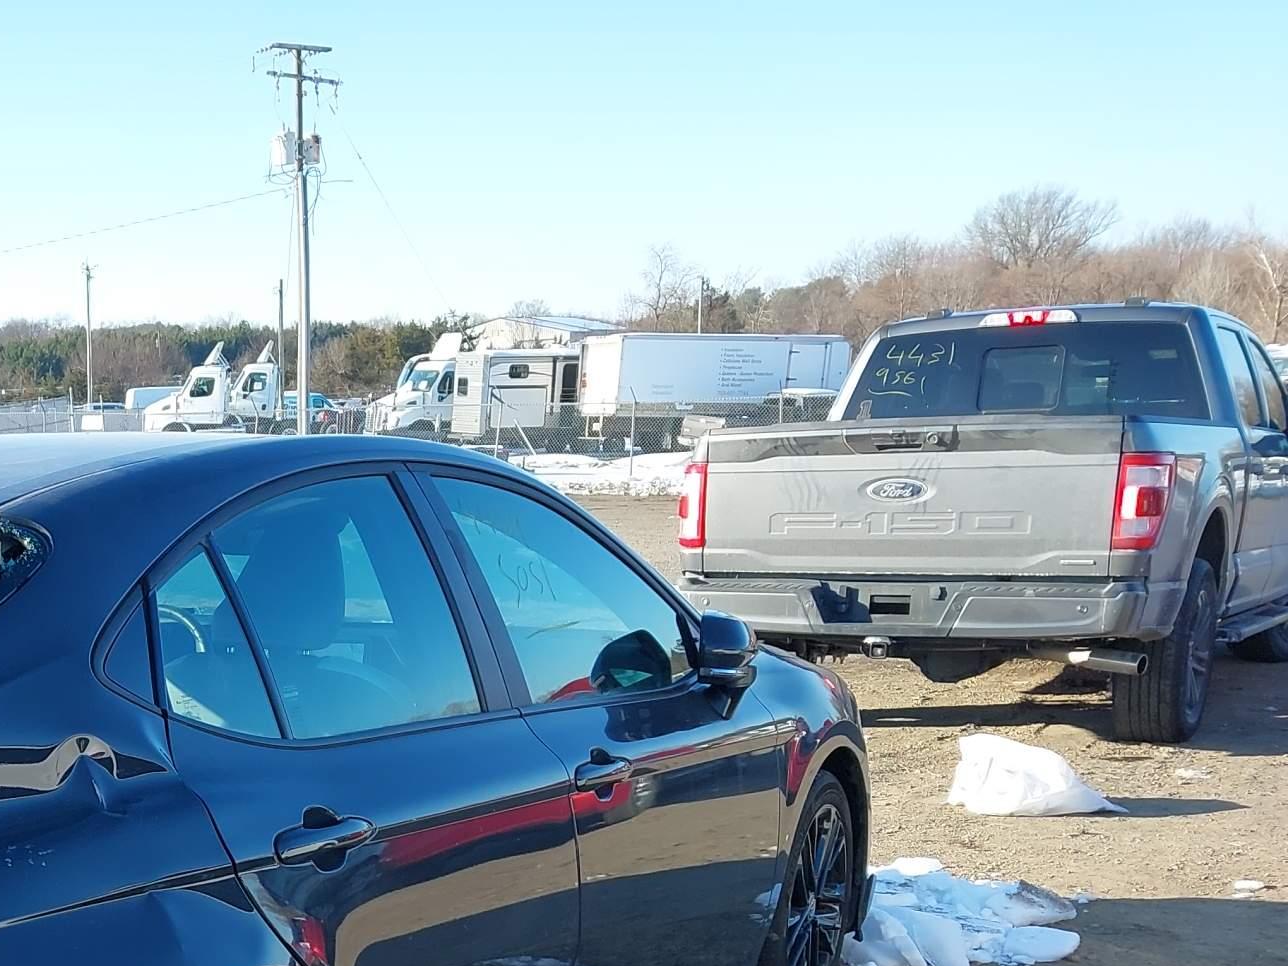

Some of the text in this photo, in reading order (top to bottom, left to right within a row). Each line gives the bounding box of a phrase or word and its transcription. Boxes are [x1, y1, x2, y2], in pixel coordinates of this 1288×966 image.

[885, 341, 956, 368] 4431
[879, 483, 913, 498] Ford
[768, 510, 1032, 536] F-150
